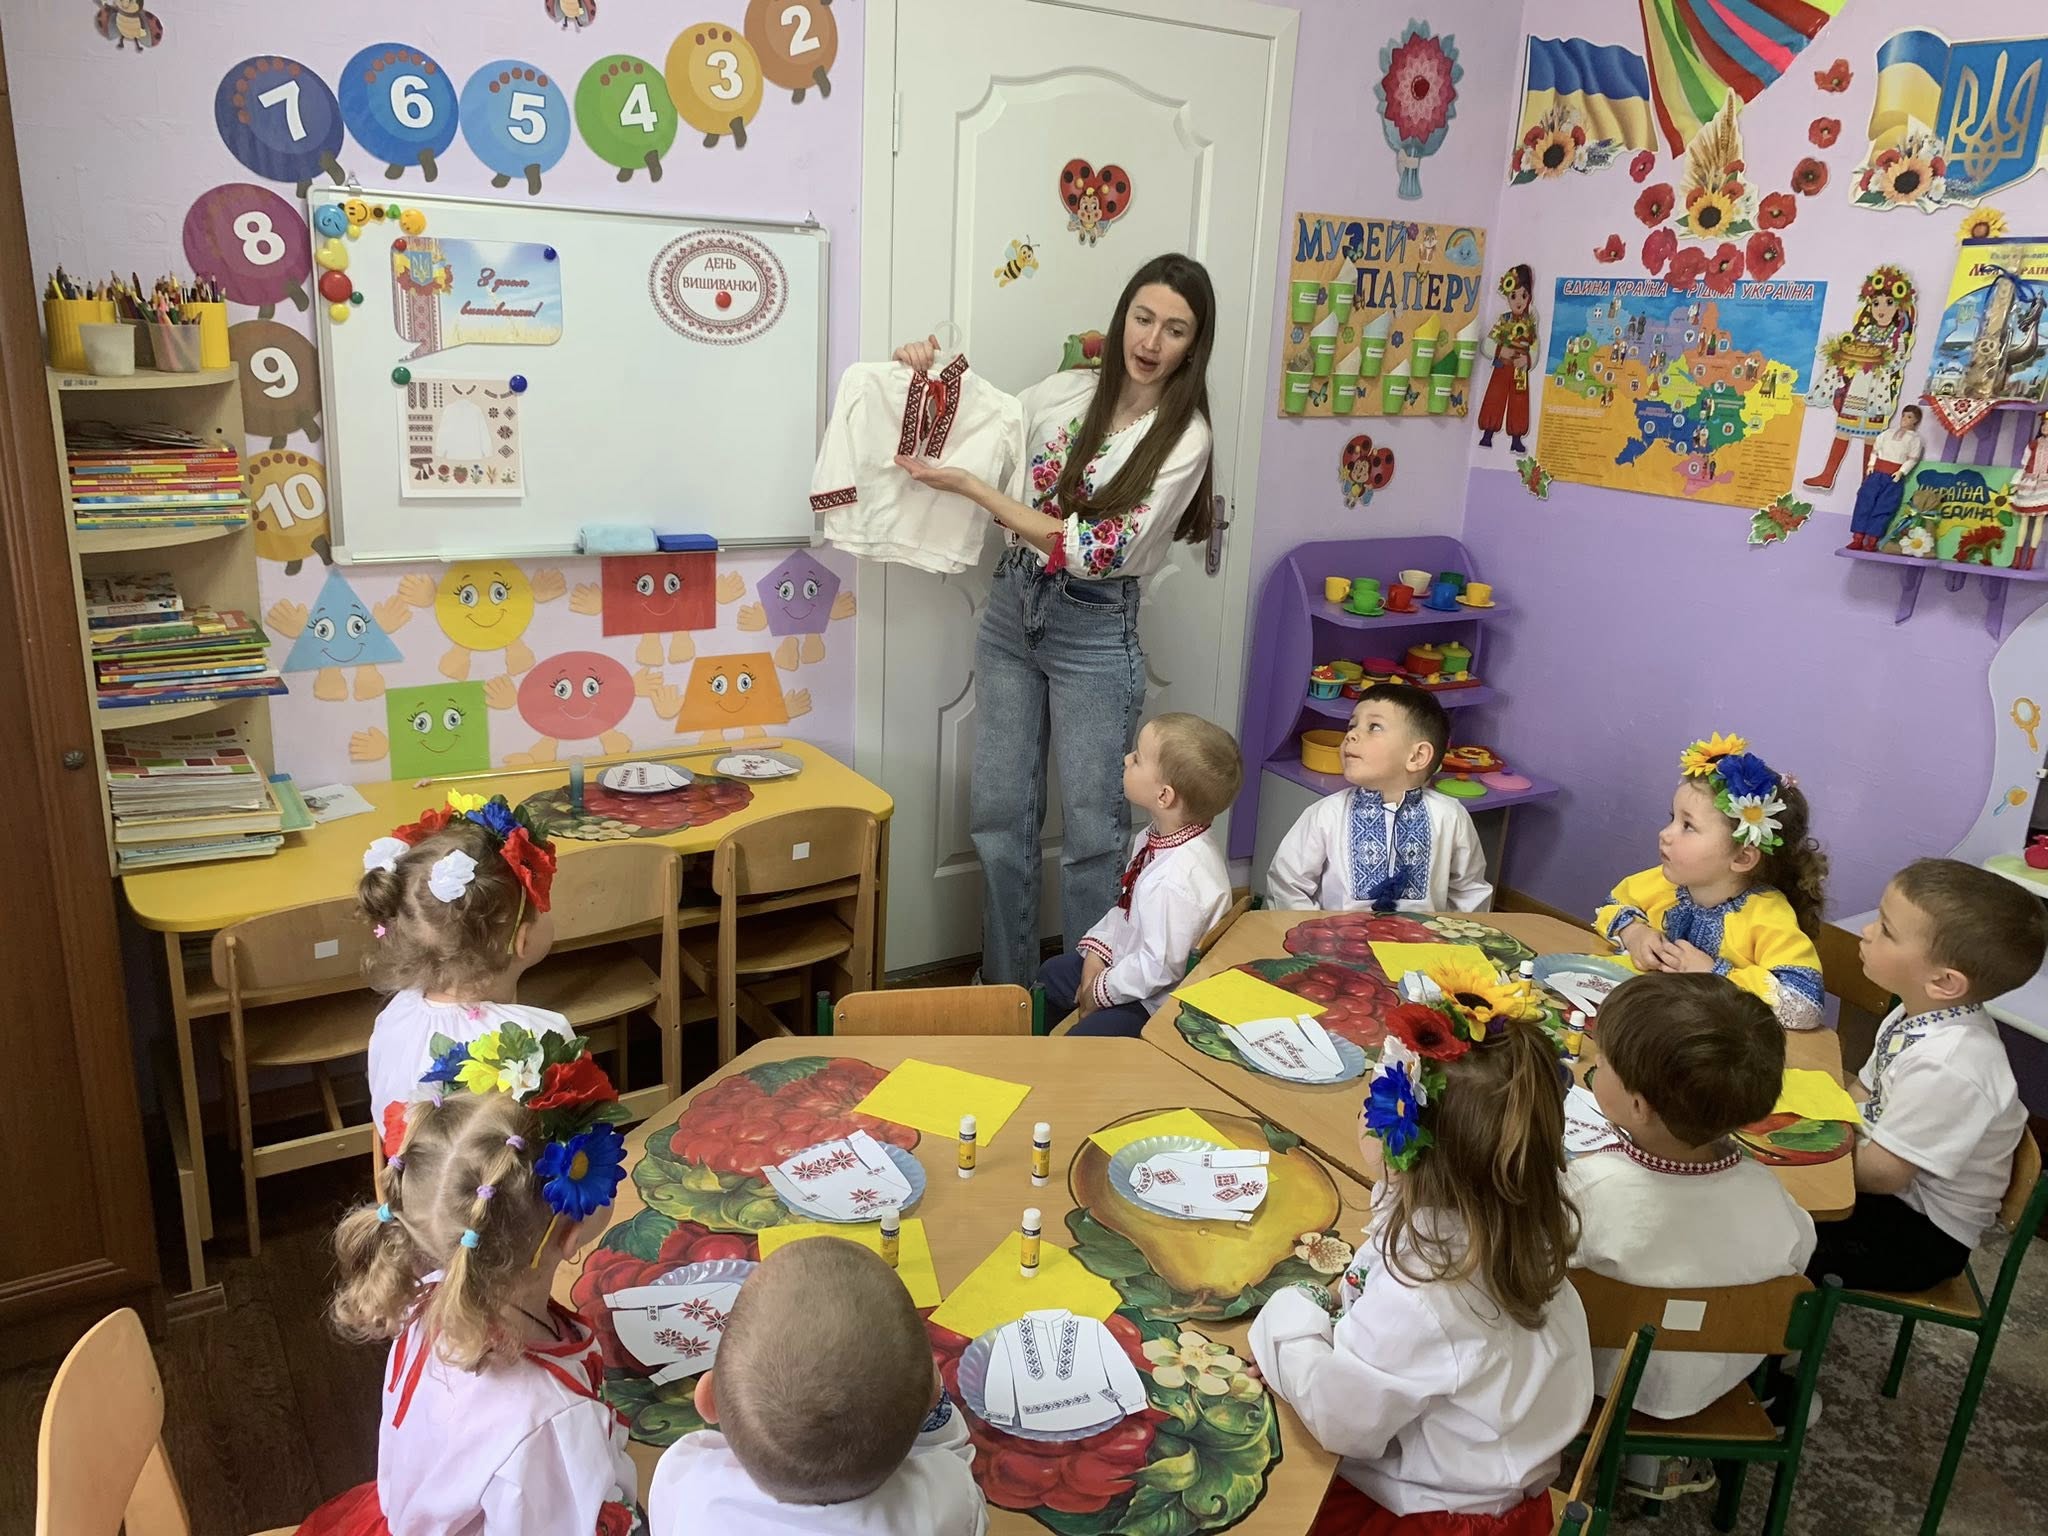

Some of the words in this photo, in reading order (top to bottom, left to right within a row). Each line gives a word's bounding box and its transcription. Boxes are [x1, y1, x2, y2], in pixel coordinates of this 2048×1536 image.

[780, 4, 820, 57] 2
[705, 50, 744, 100] 3
[258, 80, 307, 141] 7
[390, 75, 434, 128] 6
[507, 91, 548, 145] 5
[619, 82, 659, 133] 4
[233, 211, 285, 265] 8
[1295, 217, 1408, 263] МУЗЕЙ
[682, 277, 758, 292] ВИШИВАНКИ
[704, 257, 737, 271] ДЕНЬ
[1356, 267, 1481, 312] ПАПЕРУ
[1563, 280, 1610, 296] ЄДИНА
[1614, 281, 1668, 298] КРАЇНА
[1741, 280, 1815, 300] УКРАЇНА
[250, 347, 299, 398] 9
[255, 473, 327, 529] 10
[1941, 505, 1995, 522] ЄДИНА
